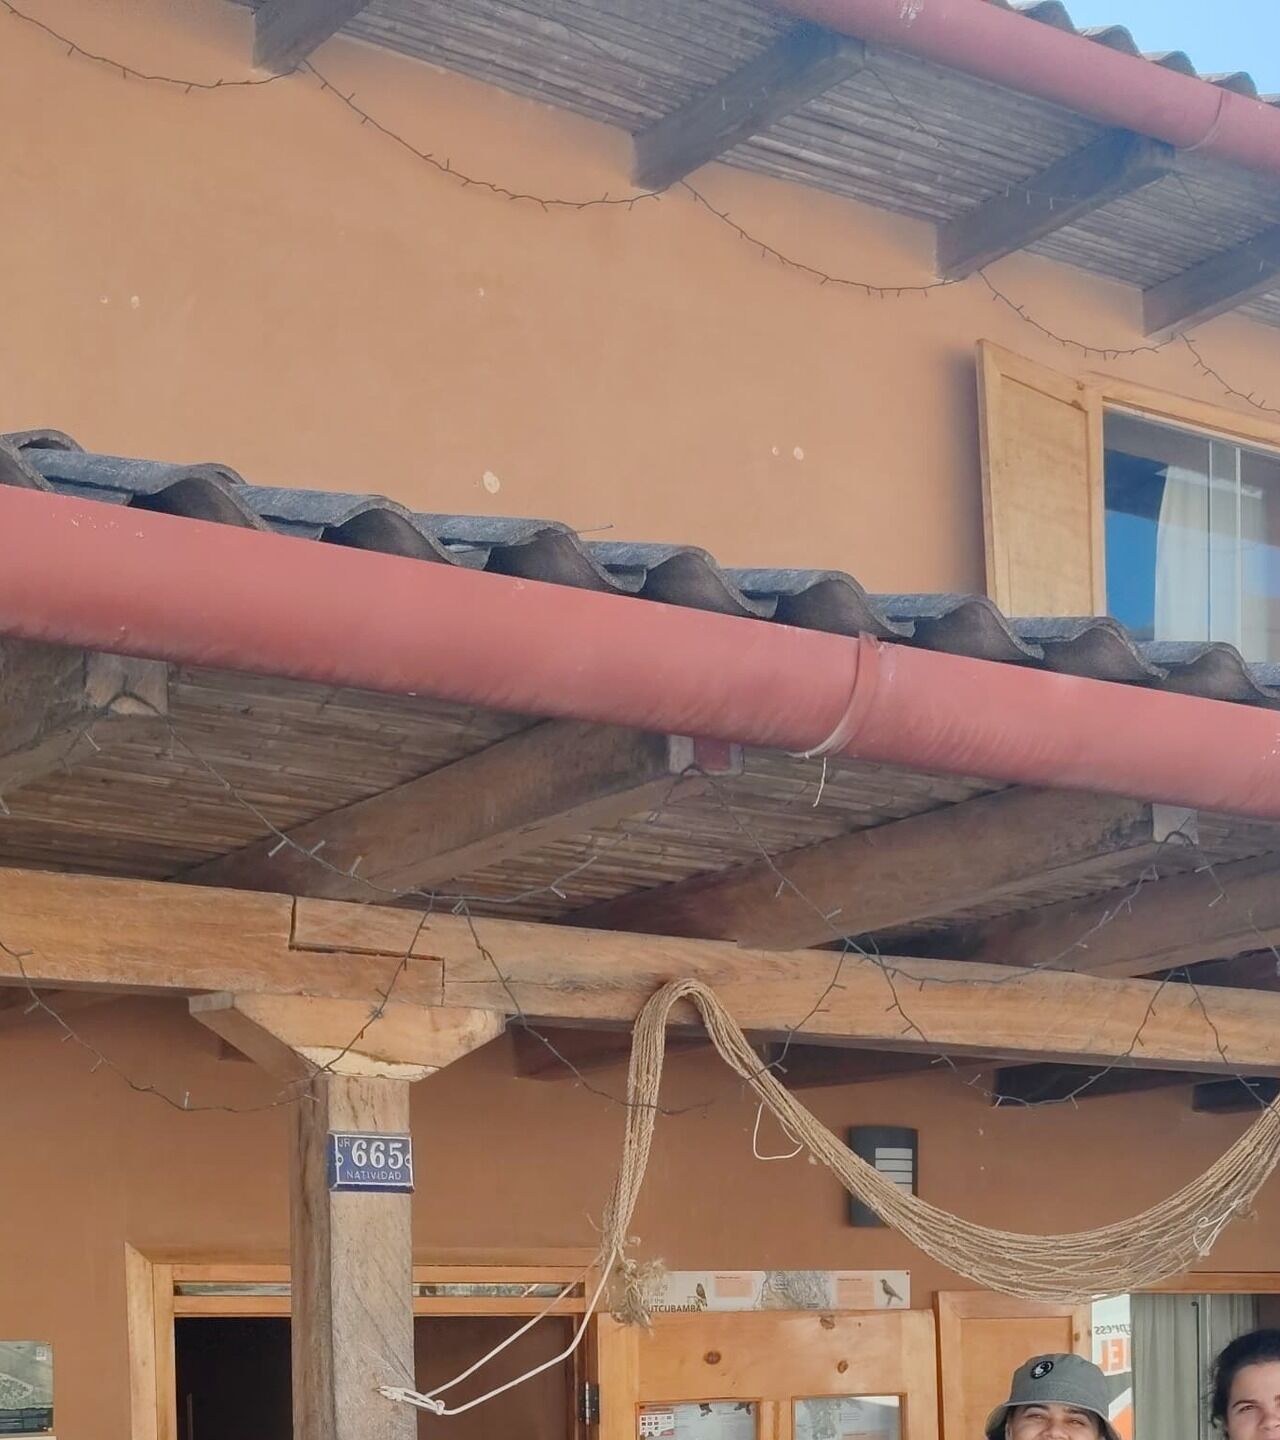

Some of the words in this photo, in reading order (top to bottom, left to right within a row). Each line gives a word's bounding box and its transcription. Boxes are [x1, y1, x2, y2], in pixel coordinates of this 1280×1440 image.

[338, 1138, 351, 1147] JR
[351, 1140, 404, 1169] 665
[346, 1170, 402, 1180] NATIVIDAD
